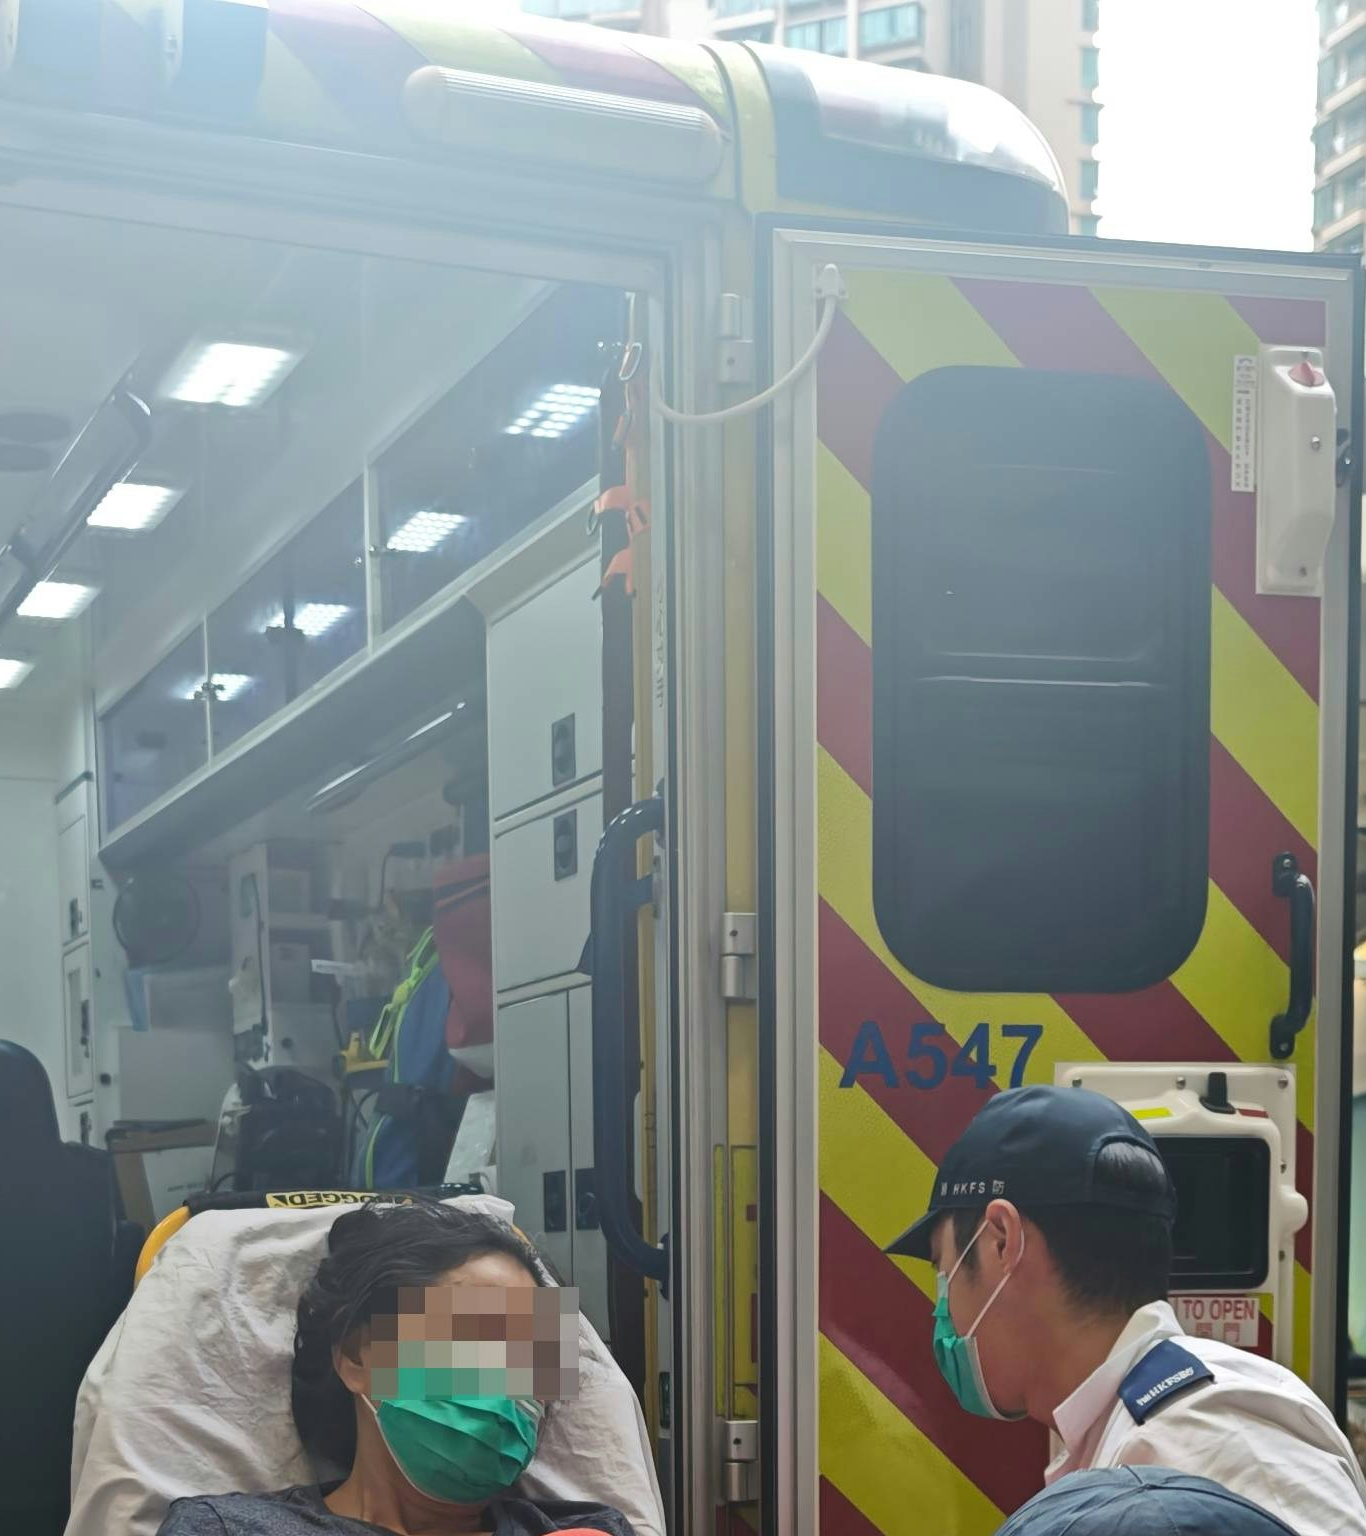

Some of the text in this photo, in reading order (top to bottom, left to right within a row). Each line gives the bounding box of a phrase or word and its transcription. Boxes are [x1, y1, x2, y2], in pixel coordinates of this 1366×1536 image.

[839, 1020, 1043, 1090] A547
[953, 1182, 986, 1196] HKFS
[1183, 1300, 1204, 1320] TO
[1210, 1300, 1255, 1320] OPEN
